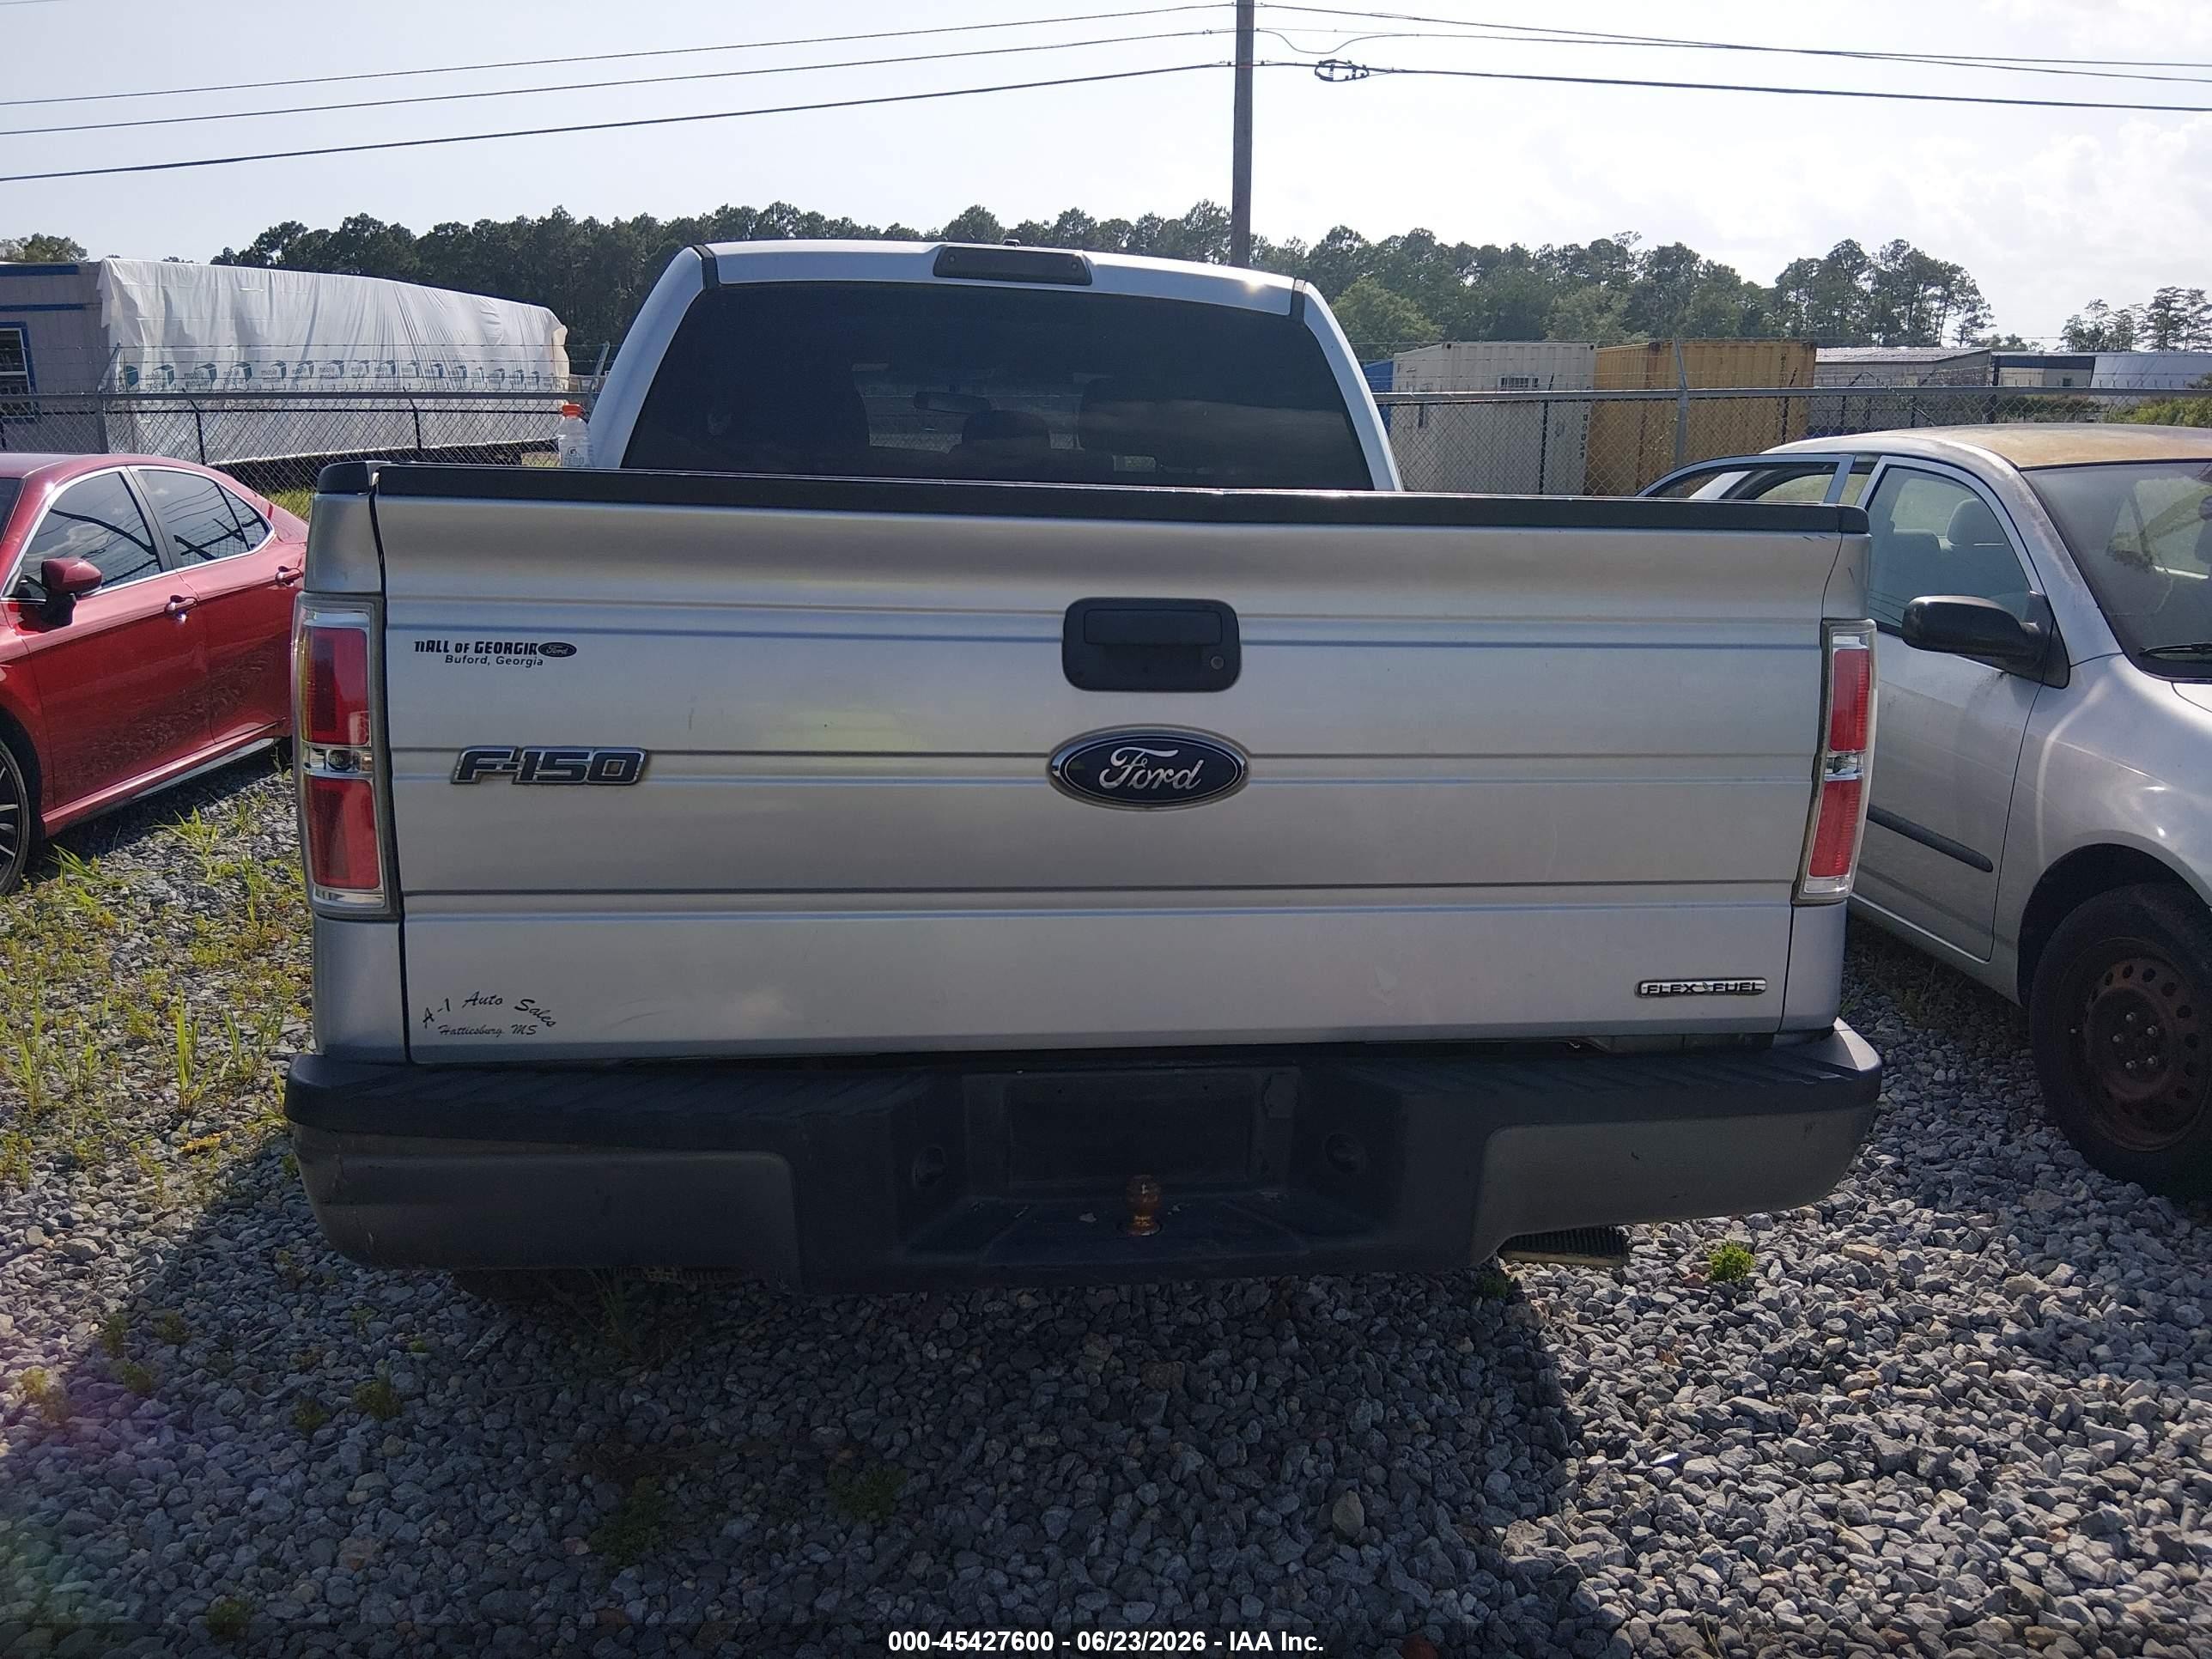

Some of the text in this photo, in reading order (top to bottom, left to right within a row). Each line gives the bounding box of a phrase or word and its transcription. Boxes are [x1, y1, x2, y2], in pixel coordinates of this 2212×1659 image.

[454, 642, 470, 653] OF
[474, 641, 538, 655] GEORGIA
[445, 654, 544, 668] Buford, Georgia
[451, 745, 646, 785] F-150
[1099, 746, 1205, 789] Ford
[1646, 981, 1765, 995] FLEX FUEL
[462, 991, 503, 1008] Auto
[514, 999, 556, 1028] Sales
[511, 1024, 538, 1036] MS
